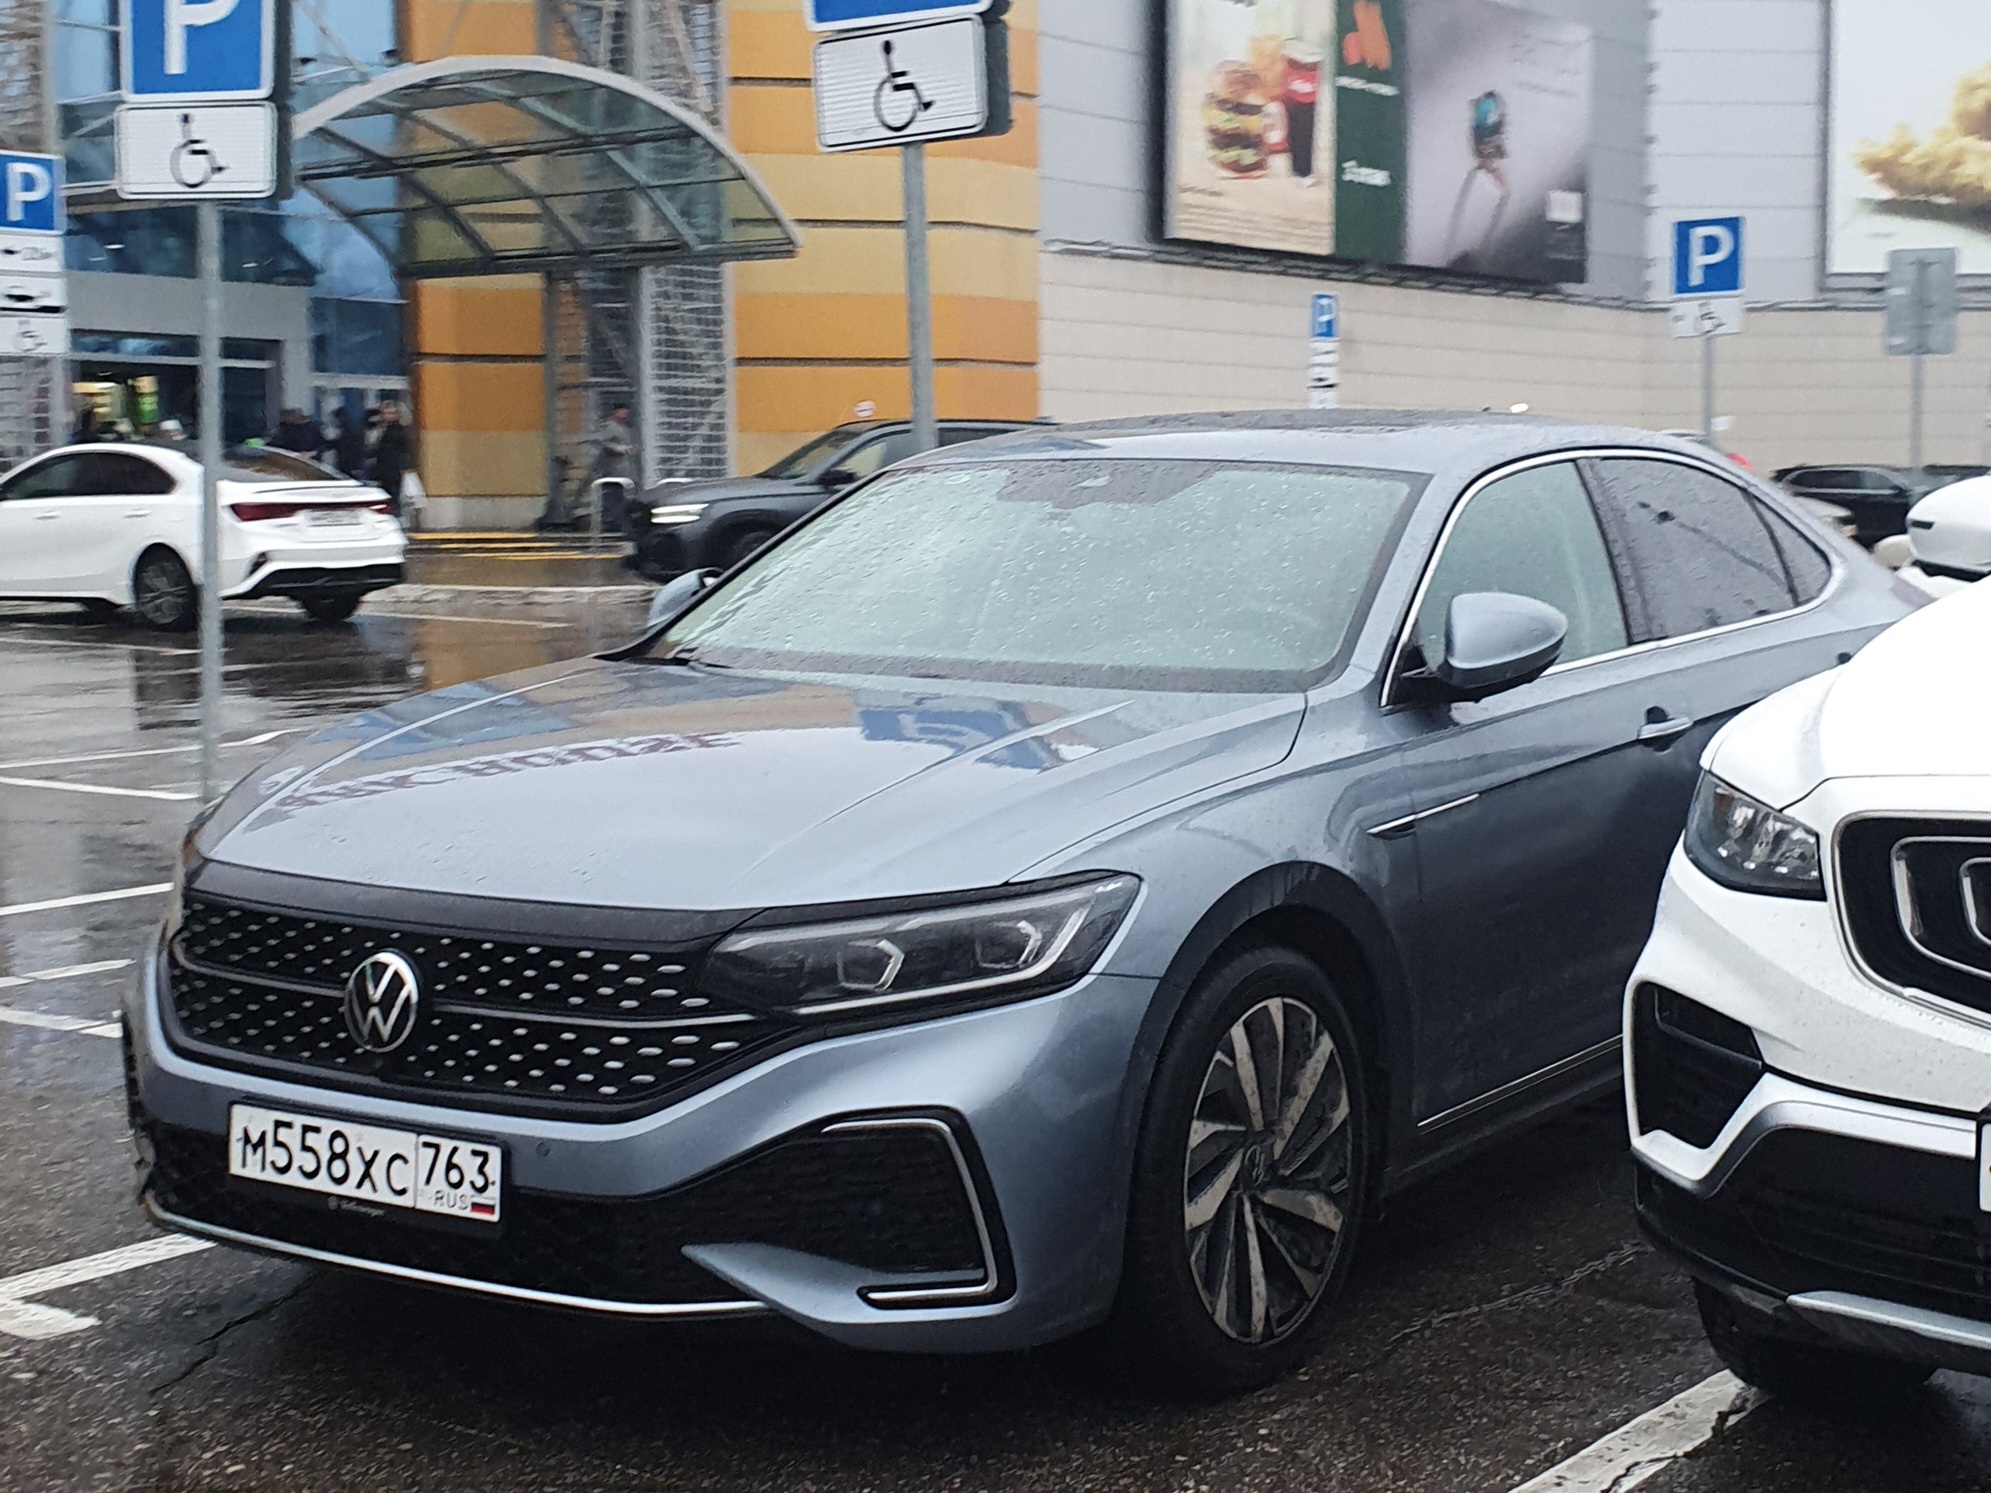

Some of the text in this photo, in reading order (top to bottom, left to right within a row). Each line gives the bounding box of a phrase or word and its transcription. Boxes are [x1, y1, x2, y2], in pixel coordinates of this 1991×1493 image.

[163, 0, 240, 75] P
[6, 161, 52, 221] P
[1687, 225, 1734, 287] P
[420, 1141, 490, 1195] 763
[433, 1189, 470, 1211] RUS
